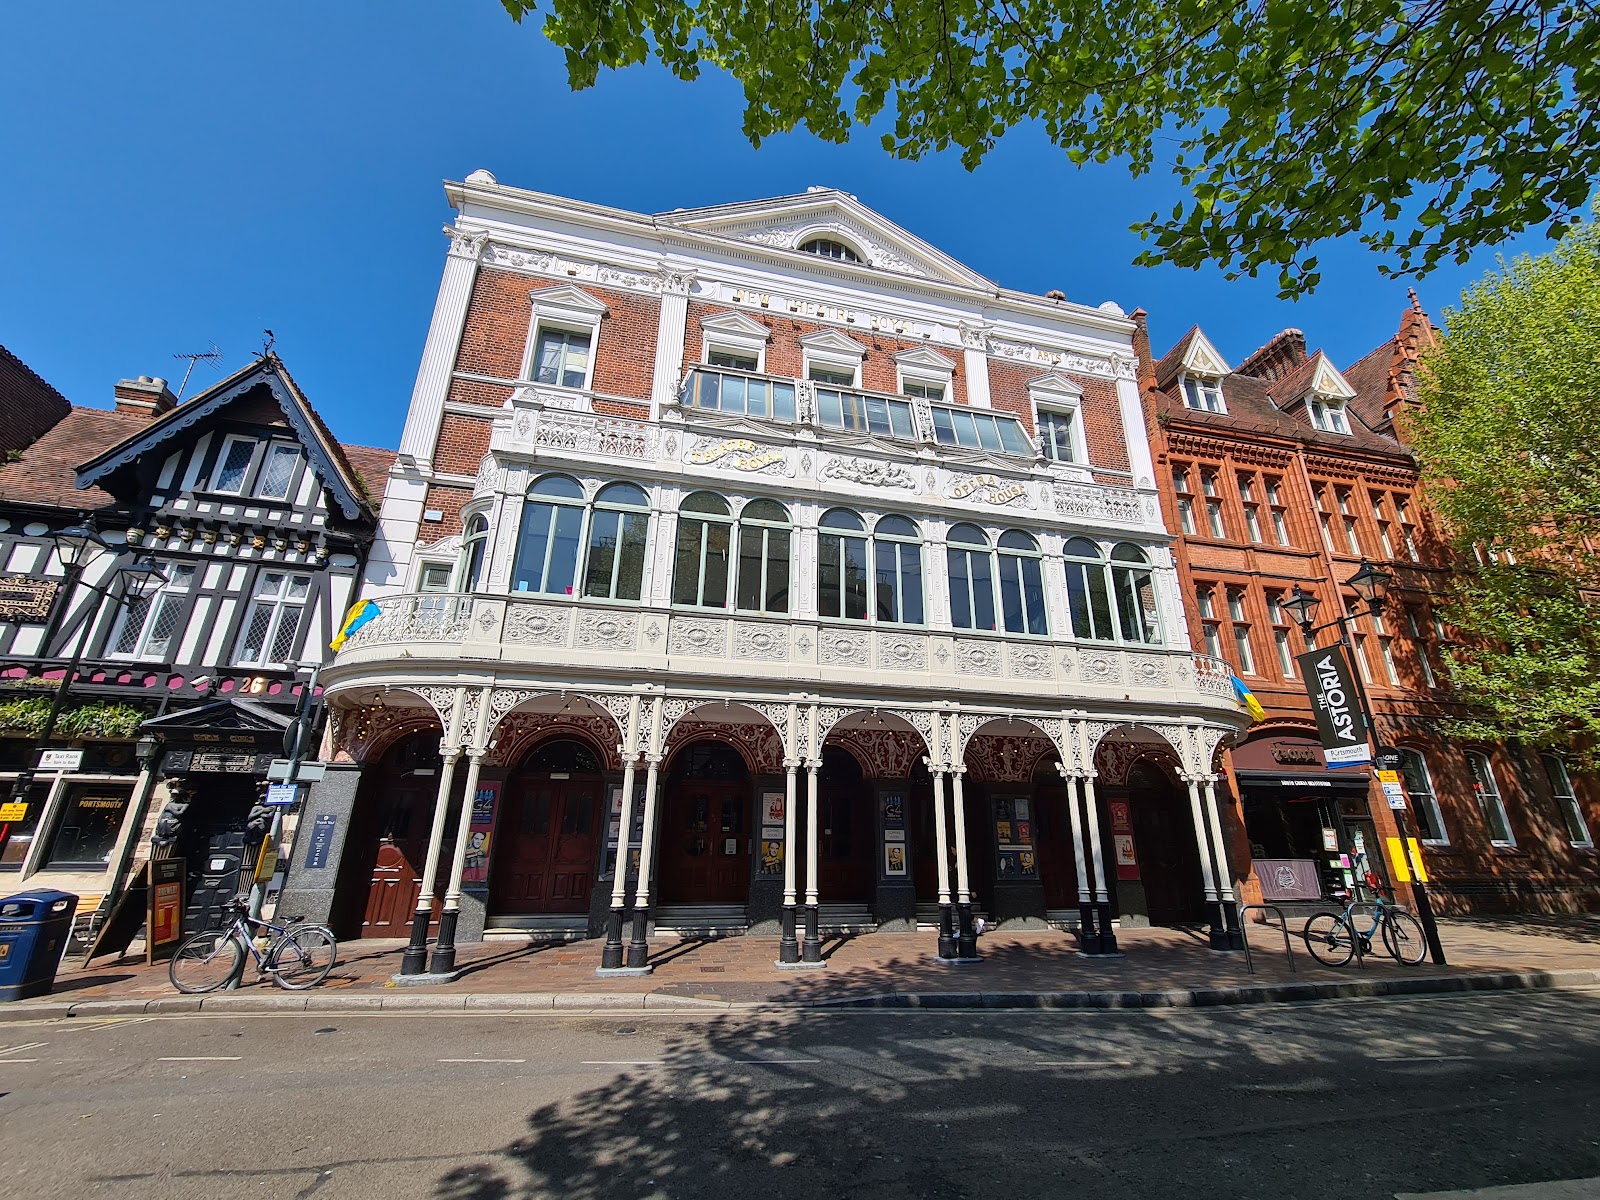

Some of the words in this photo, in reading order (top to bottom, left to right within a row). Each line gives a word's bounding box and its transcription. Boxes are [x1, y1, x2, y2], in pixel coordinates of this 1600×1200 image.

[737, 289, 769, 305] NEW
[785, 299, 855, 322] THEATRE
[870, 315, 922, 334] ROYAL
[1037, 351, 1062, 361] ARTS
[691, 440, 756, 462] THEATRE
[738, 452, 783, 470] ROYAL
[954, 475, 996, 497] OPERA
[989, 484, 1026, 503] HOUSE
[239, 676, 264, 694] 26
[1316, 654, 1357, 741] ASTORIA
[1316, 692, 1328, 711] THE
[79, 800, 123, 808] PORTSMOUTH
